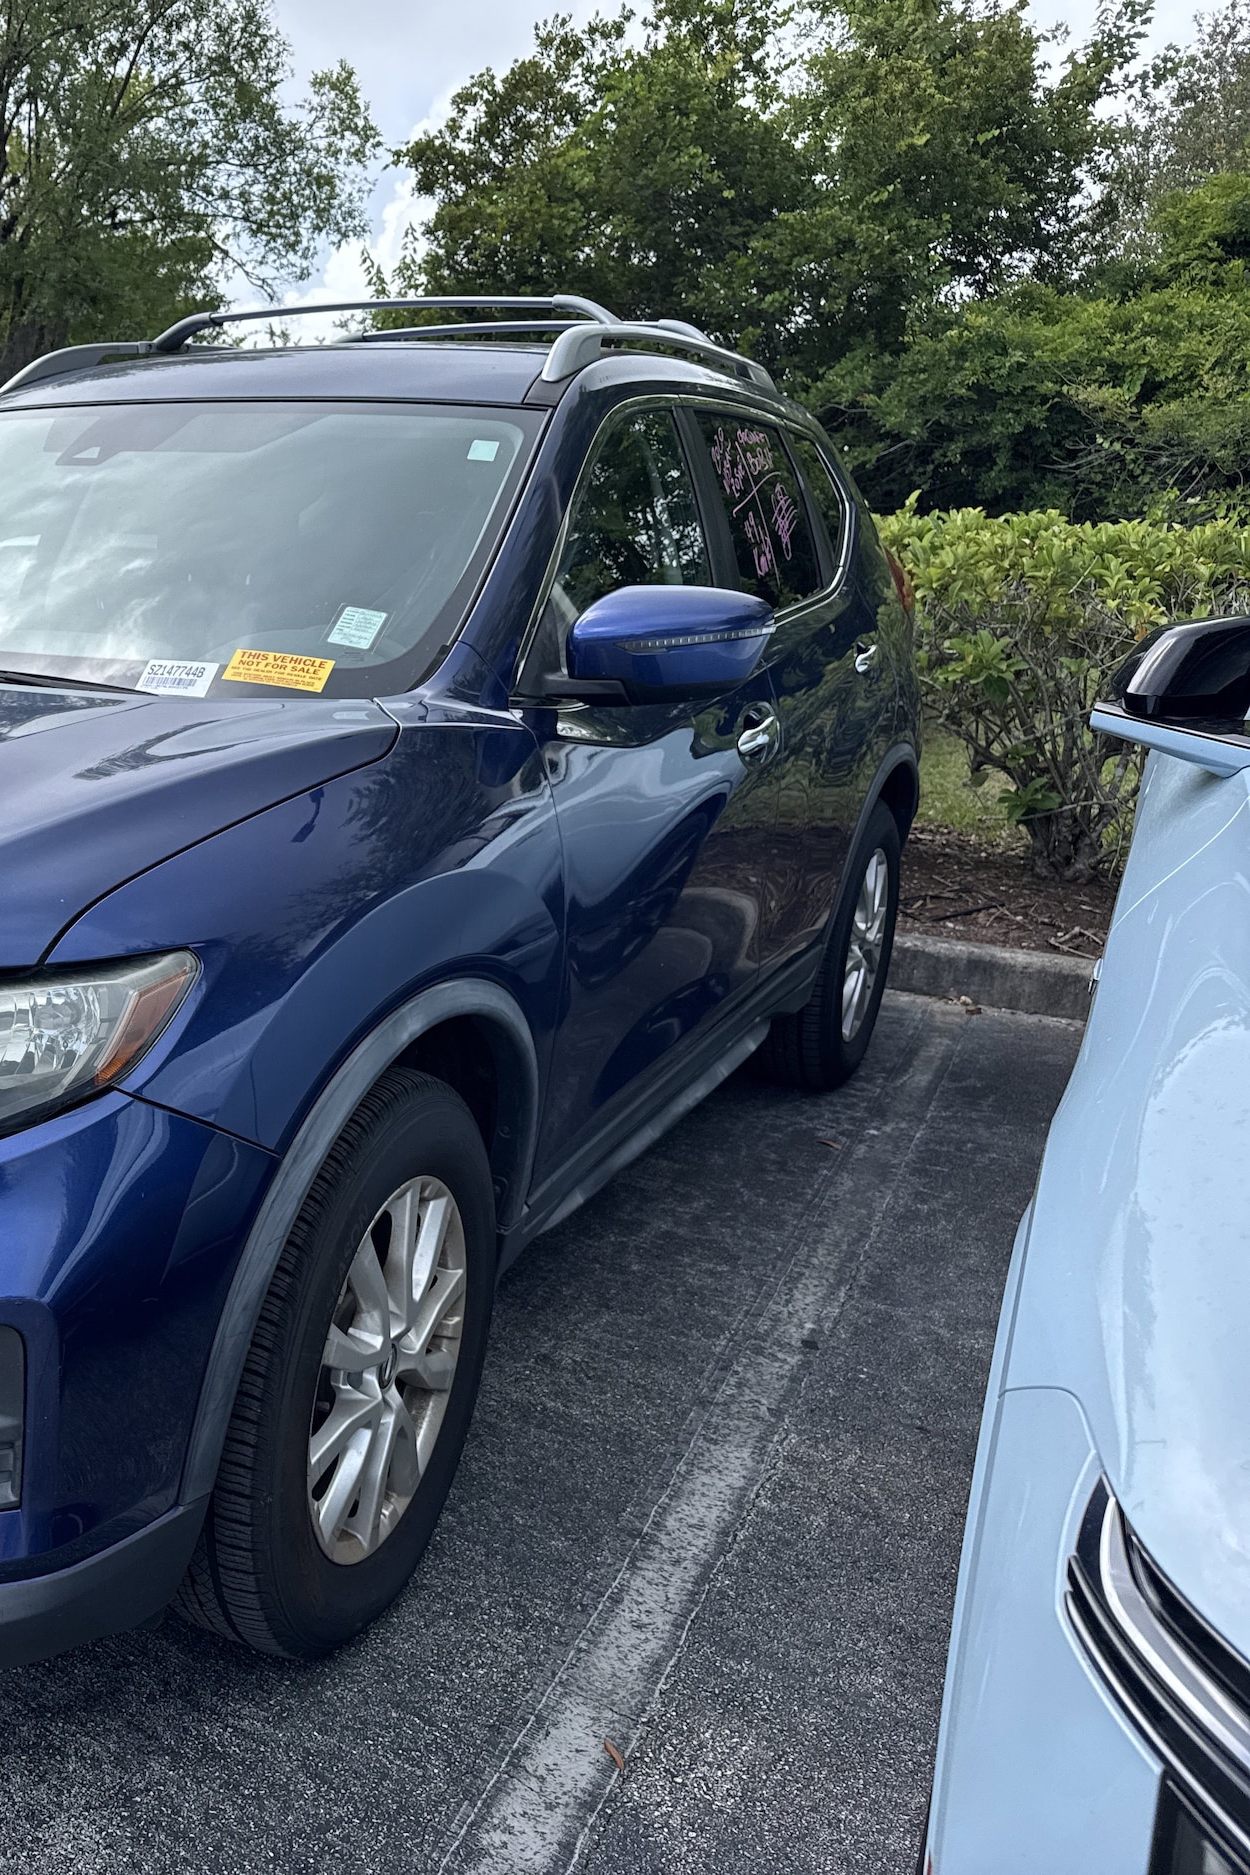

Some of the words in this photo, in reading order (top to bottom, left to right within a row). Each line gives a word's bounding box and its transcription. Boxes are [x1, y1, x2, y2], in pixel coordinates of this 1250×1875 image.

[240, 651, 269, 661] THIS
[273, 654, 327, 669] VEHICLE
[264, 663, 288, 671] FOR
[290, 666, 321, 675] SALE
